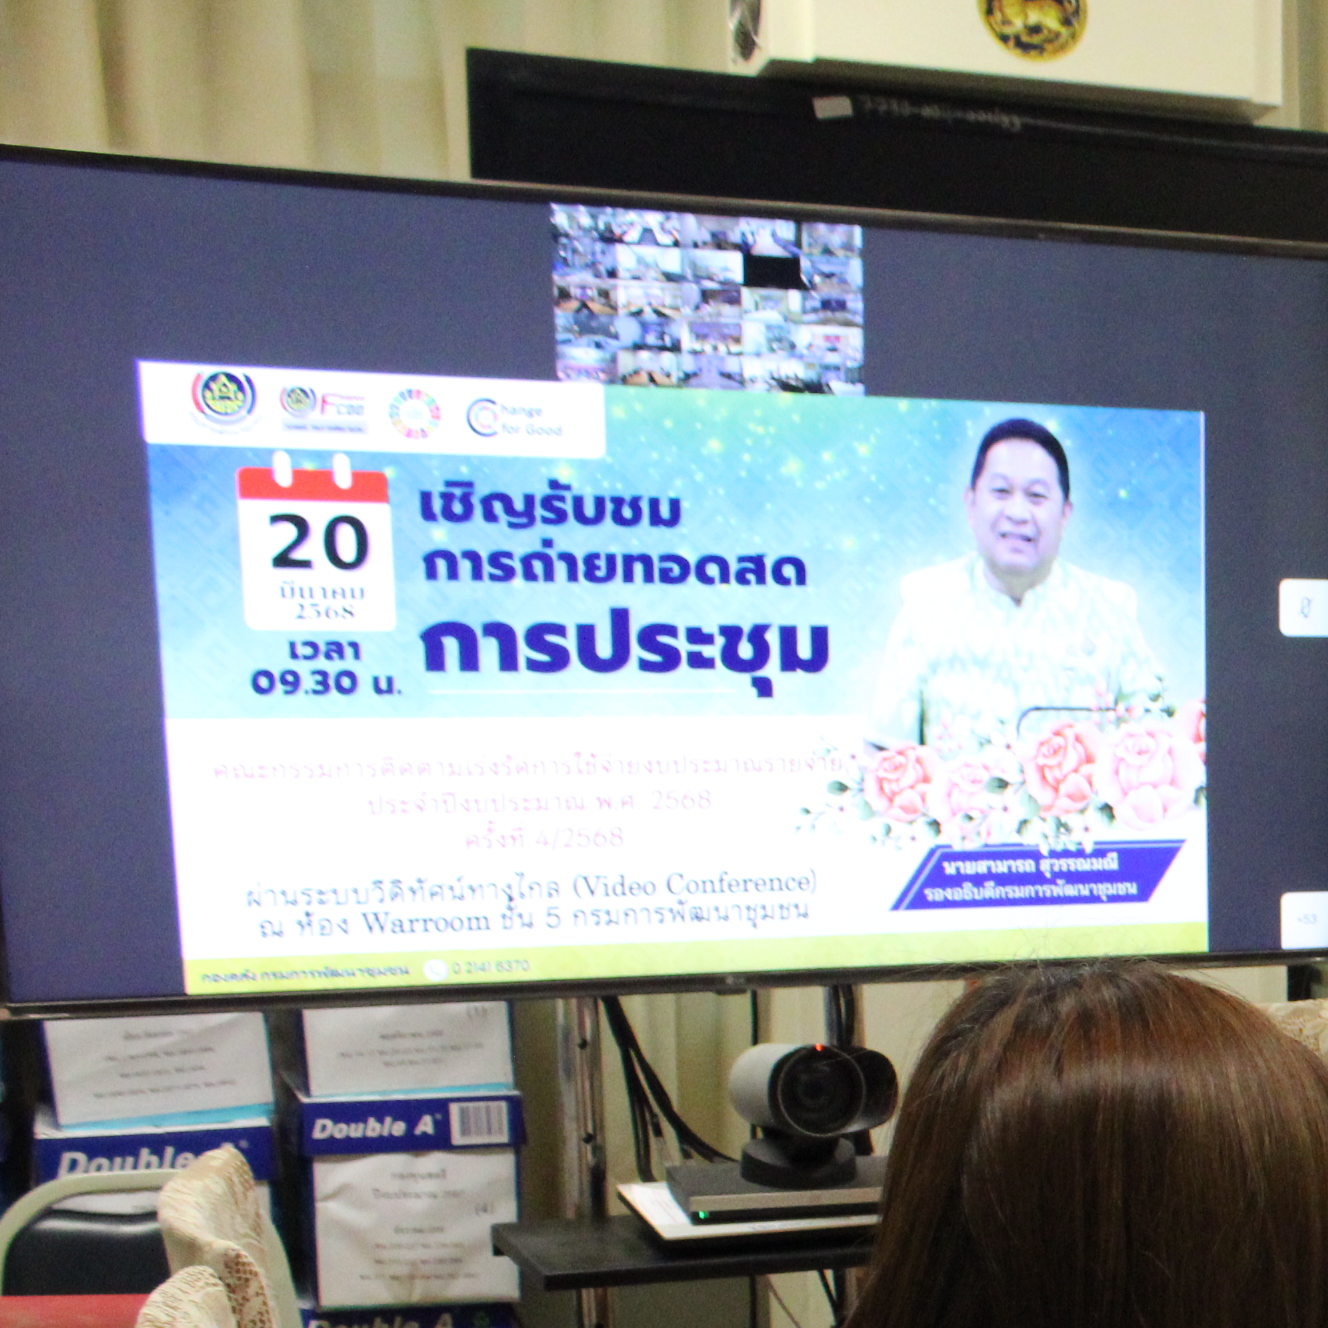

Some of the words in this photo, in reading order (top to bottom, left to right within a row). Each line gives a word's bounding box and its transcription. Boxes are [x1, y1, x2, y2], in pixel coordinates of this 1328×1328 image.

[418, 477, 682, 530] เชิญรับชม
[269, 512, 370, 571] 20
[422, 537, 808, 586] การถ่ายทอดสด
[280, 580, 366, 600] มีนาคม
[294, 603, 356, 621] 2568
[287, 638, 361, 661] เวลา
[419, 606, 829, 699] การประชุม
[251, 669, 358, 697] 09.30
[372, 674, 402, 696] น.
[651, 788, 712, 811] 2568
[572, 873, 657, 899] (Video
[666, 868, 818, 896] Conference)
[259, 917, 284, 938] ณ
[296, 910, 350, 937] ห้อง
[361, 910, 491, 935] Warroom
[545, 906, 562, 929] 5
[572, 899, 810, 930] กรมการพัฒนาชุมชน
[312, 1115, 406, 1140] Double
[412, 1113, 436, 1137] A
